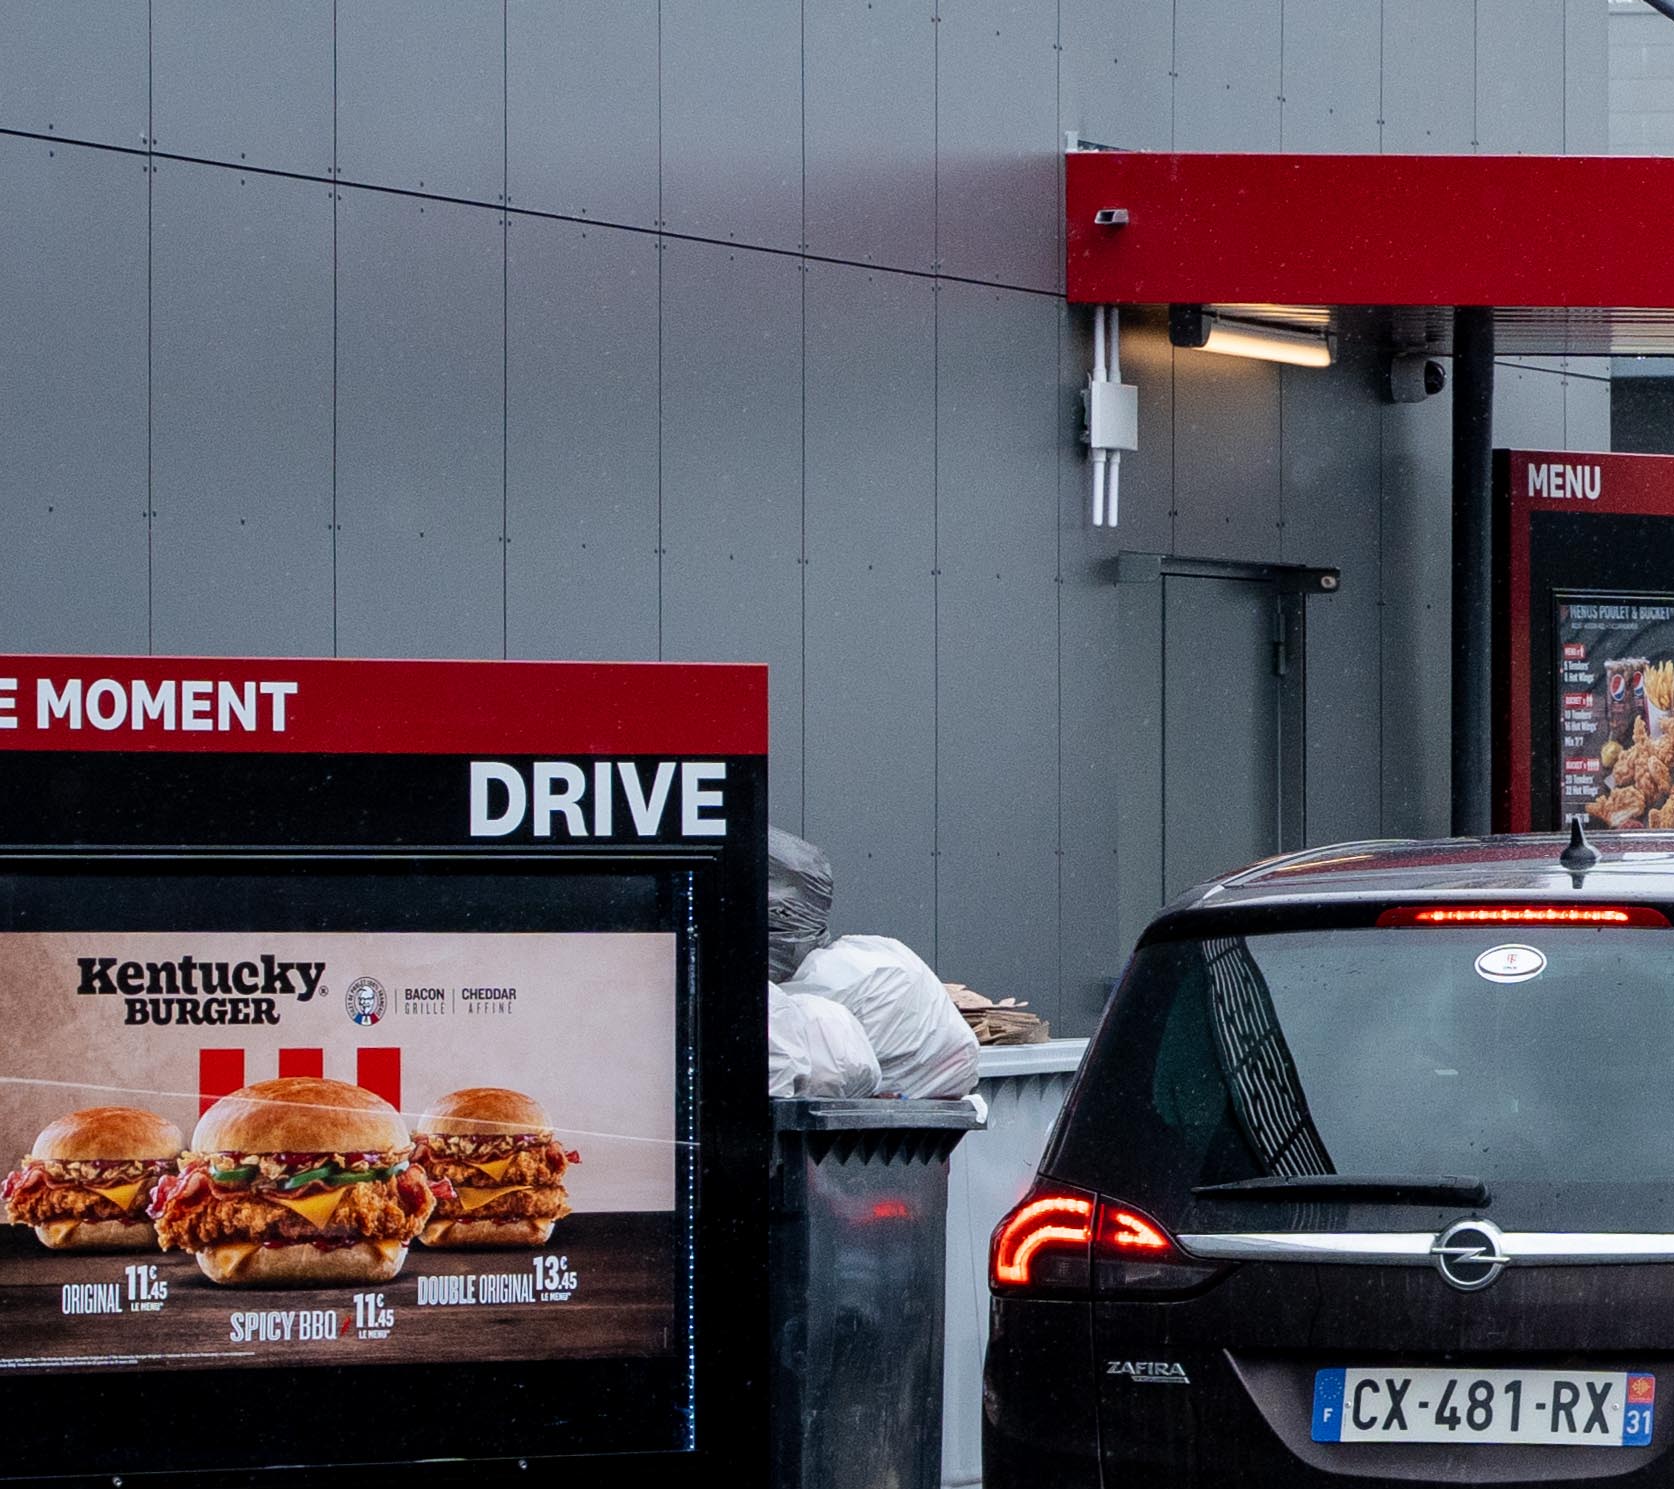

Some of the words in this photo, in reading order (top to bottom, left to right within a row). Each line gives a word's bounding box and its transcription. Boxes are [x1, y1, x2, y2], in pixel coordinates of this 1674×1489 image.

[1528, 463, 1601, 500] MENU
[37, 678, 297, 731] MOMENT
[470, 761, 727, 837] DRIVE
[405, 988, 445, 1001] BACON
[461, 988, 516, 1001] CHEDDAR
[124, 997, 281, 1025] BURGER
[62, 1283, 122, 1315] ORIGINAL
[417, 1275, 476, 1305] DOUBLE
[479, 1273, 535, 1303] ORIGINAL
[230, 1312, 295, 1342] SPICY
[299, 1311, 338, 1341] BBQ
[1106, 1361, 1186, 1376] ZAFIRA
[1323, 1408, 1333, 1422] F
[1352, 1378, 1613, 1434] CX-481-RX
[1626, 1410, 1650, 1435] 31
